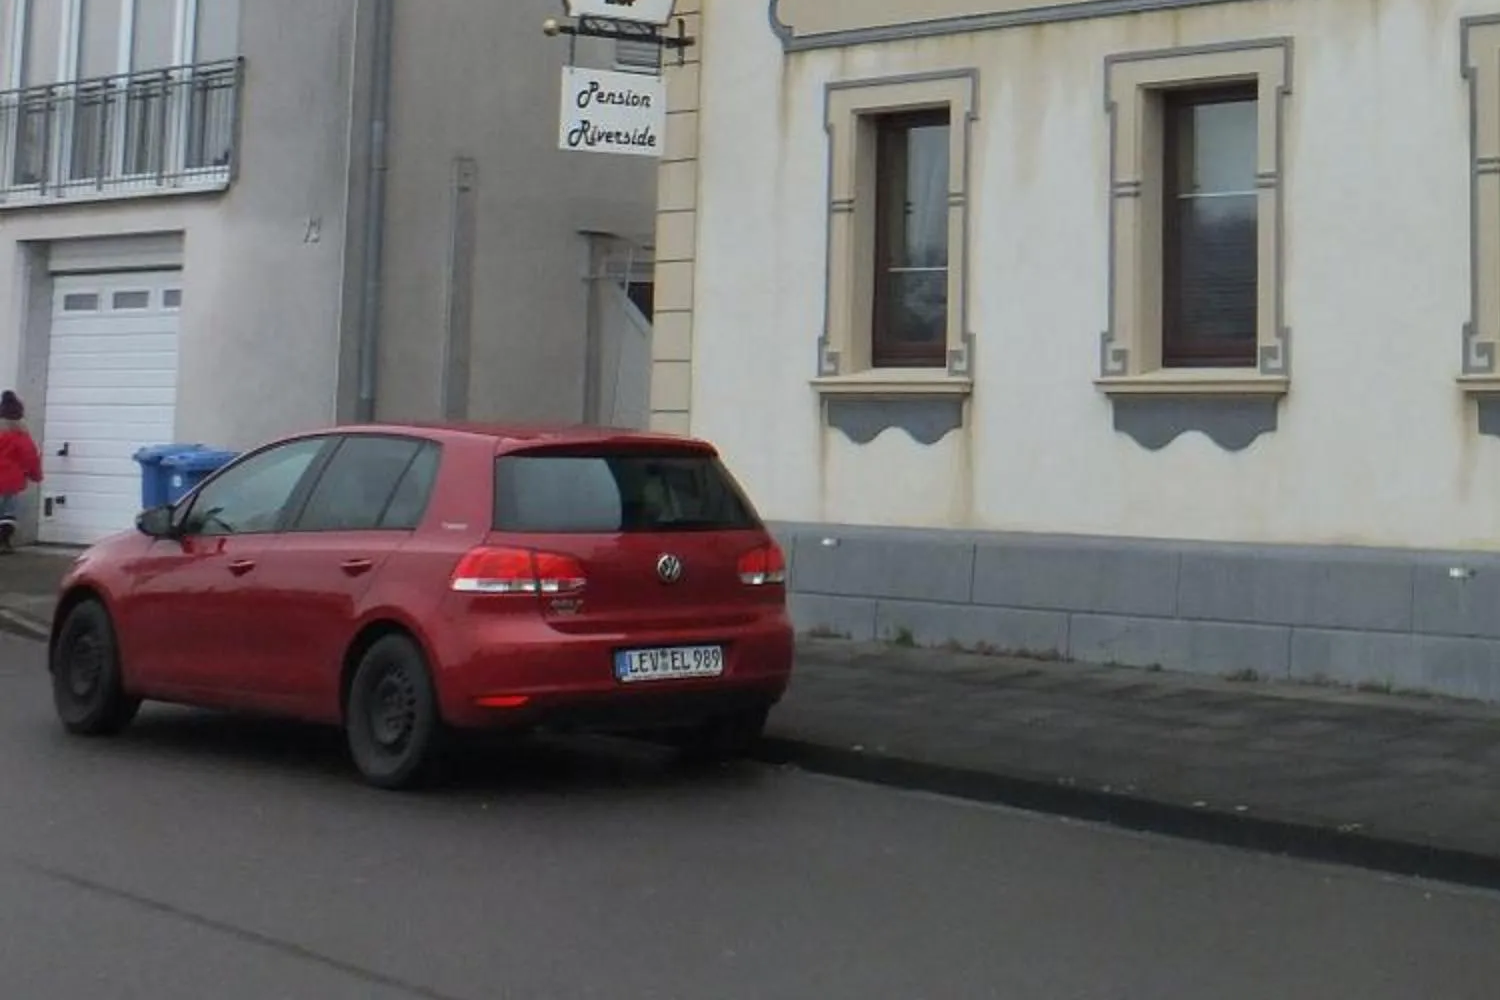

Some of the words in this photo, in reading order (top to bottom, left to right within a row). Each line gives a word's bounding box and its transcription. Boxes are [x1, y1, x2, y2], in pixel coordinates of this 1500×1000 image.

[577, 81, 651, 108] Pension
[567, 120, 657, 147] Riverside
[628, 652, 659, 673] LEV
[670, 649, 691, 671] EL
[693, 647, 720, 669] 989
